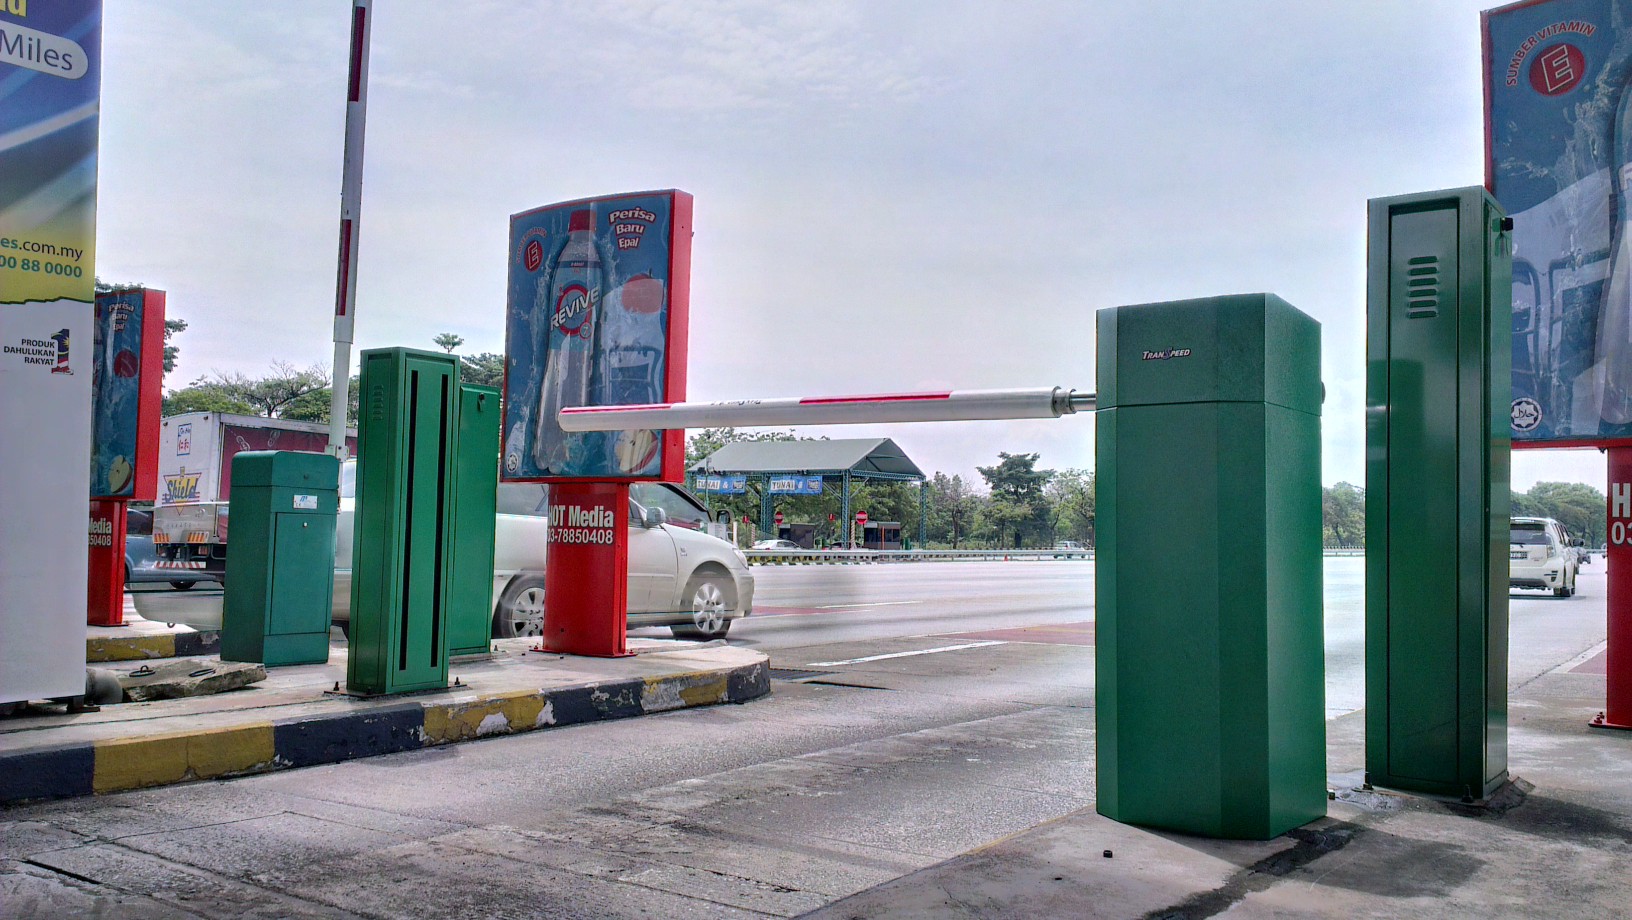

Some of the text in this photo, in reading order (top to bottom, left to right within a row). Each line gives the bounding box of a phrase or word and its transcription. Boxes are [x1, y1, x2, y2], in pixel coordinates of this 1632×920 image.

[0, 28, 72, 71] Miles
[1506, 21, 1596, 86] SUMBER VITAMIN
[608, 206, 657, 224] Perisa
[615, 224, 645, 237] Baru
[618, 237, 639, 249] Epal
[21, 258, 40, 272] 88
[45, 262, 82, 278] 0000
[550, 286, 600, 331] REVIVE
[3, 346, 55, 357] DAHULUKAN
[22, 339, 55, 349] PRODUK
[24, 356, 55, 366] RAKYAT
[165, 478, 199, 503] Shield
[548, 504, 614, 528] HOT Media
[547, 528, 613, 545] 03-78850408
